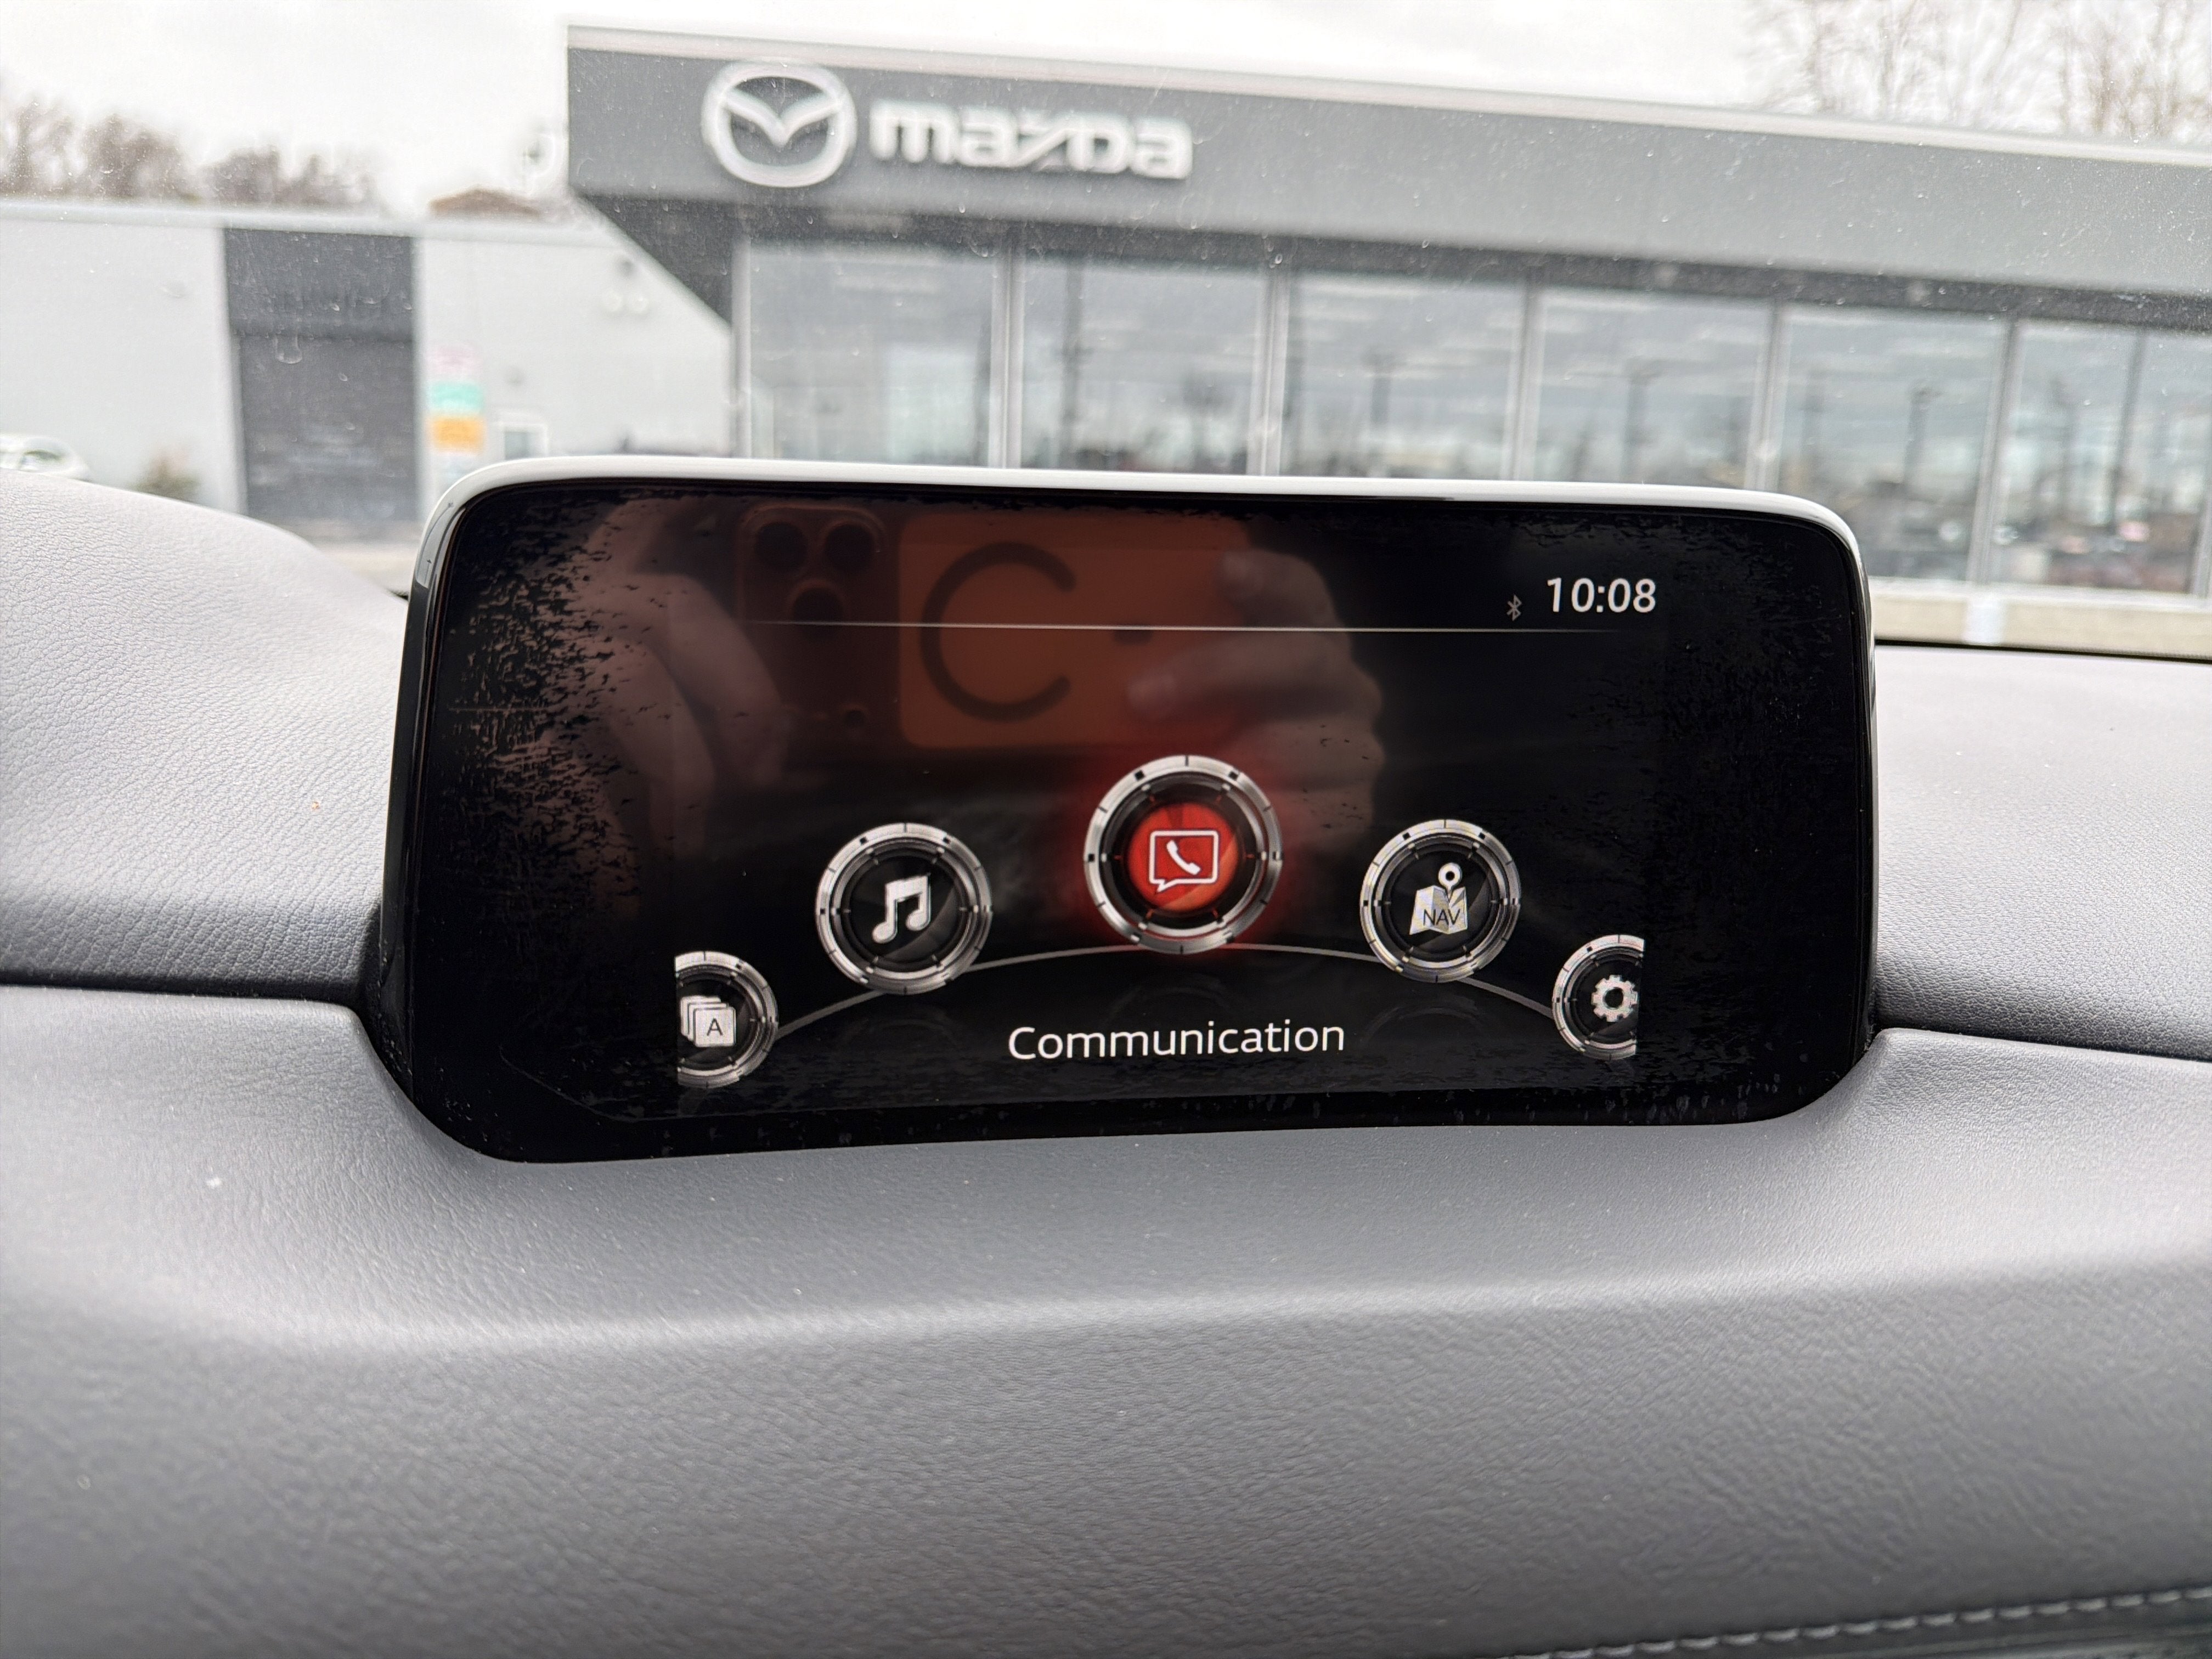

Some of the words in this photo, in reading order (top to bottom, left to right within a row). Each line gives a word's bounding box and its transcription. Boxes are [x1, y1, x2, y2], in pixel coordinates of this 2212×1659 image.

[1547, 577, 1656, 613] 10:08
[1423, 909, 1460, 926] NAV
[707, 1018, 723, 1036] A
[1008, 1019, 1345, 1060] Communication
